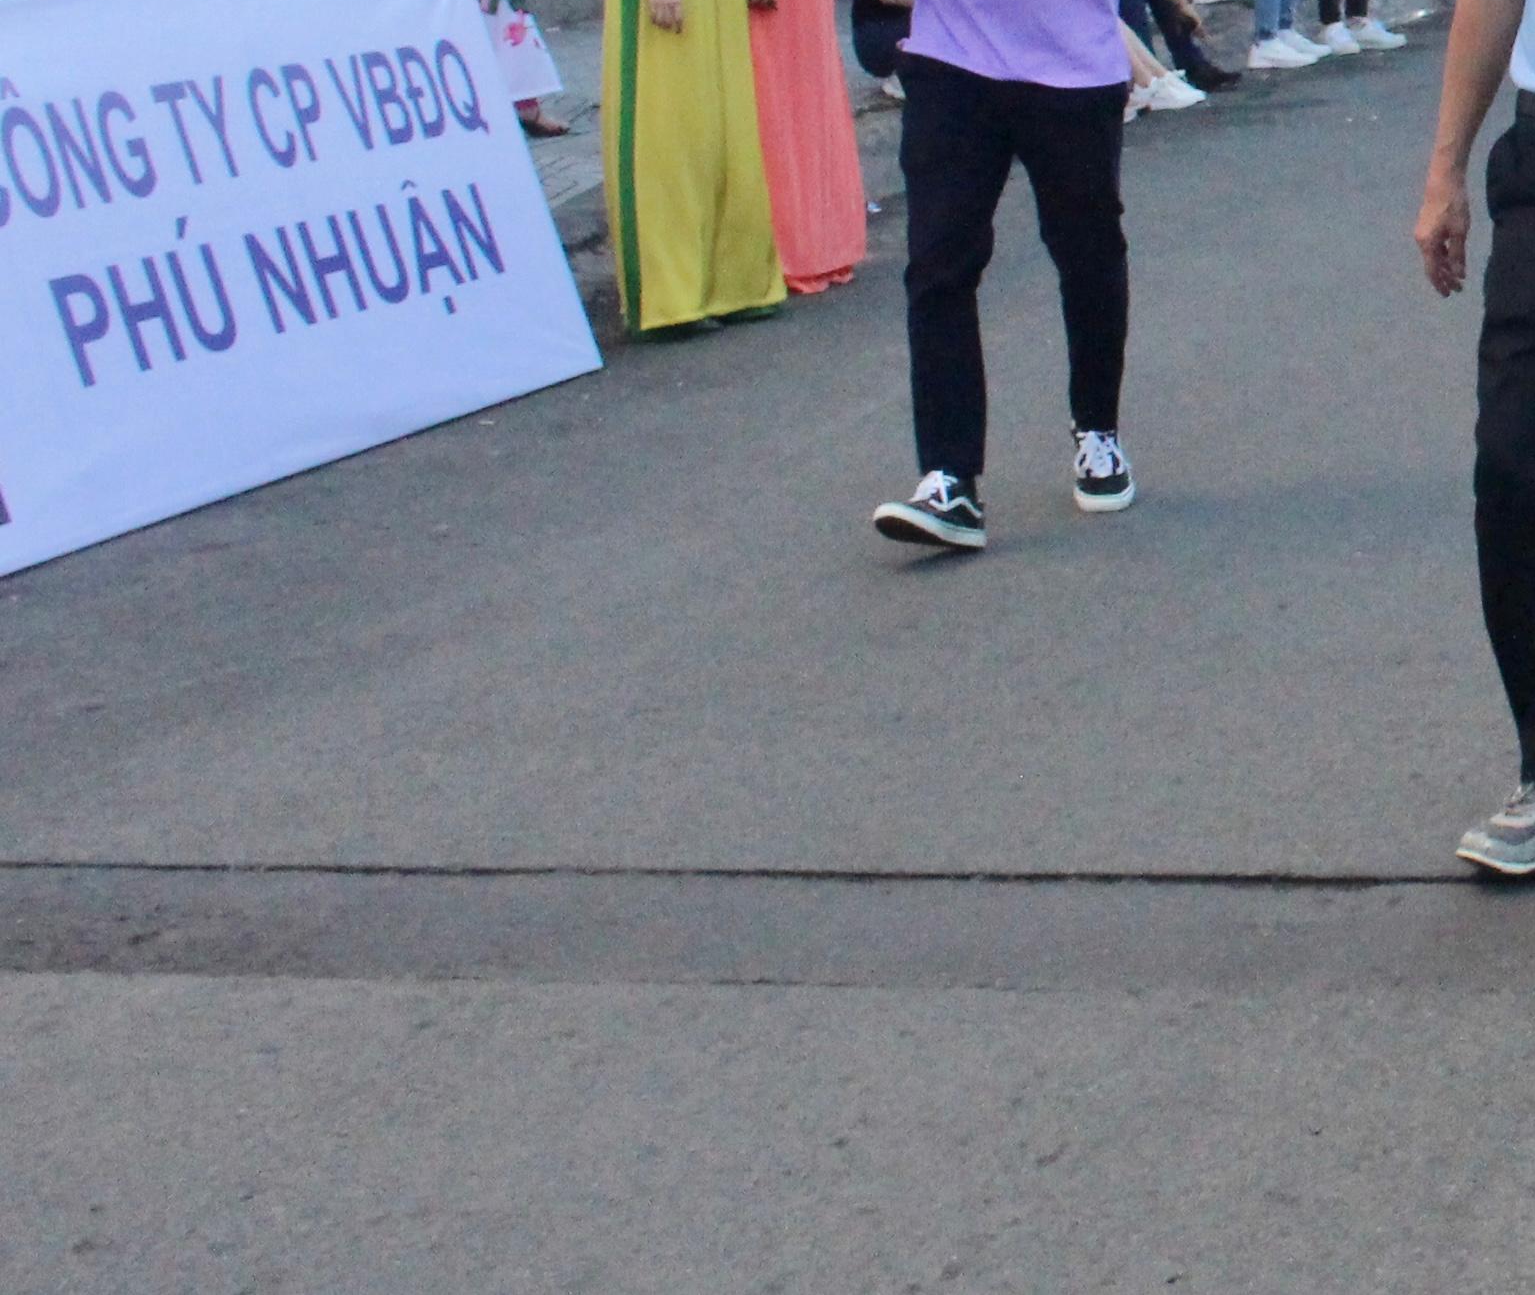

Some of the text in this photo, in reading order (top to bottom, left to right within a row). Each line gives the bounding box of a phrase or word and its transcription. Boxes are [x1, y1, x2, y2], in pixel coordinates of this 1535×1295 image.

[152, 75, 240, 184] TY
[246, 63, 322, 170] CP
[325, 37, 490, 151] VBĐQ
[49, 179, 506, 388] PHÚ NHUẬN
